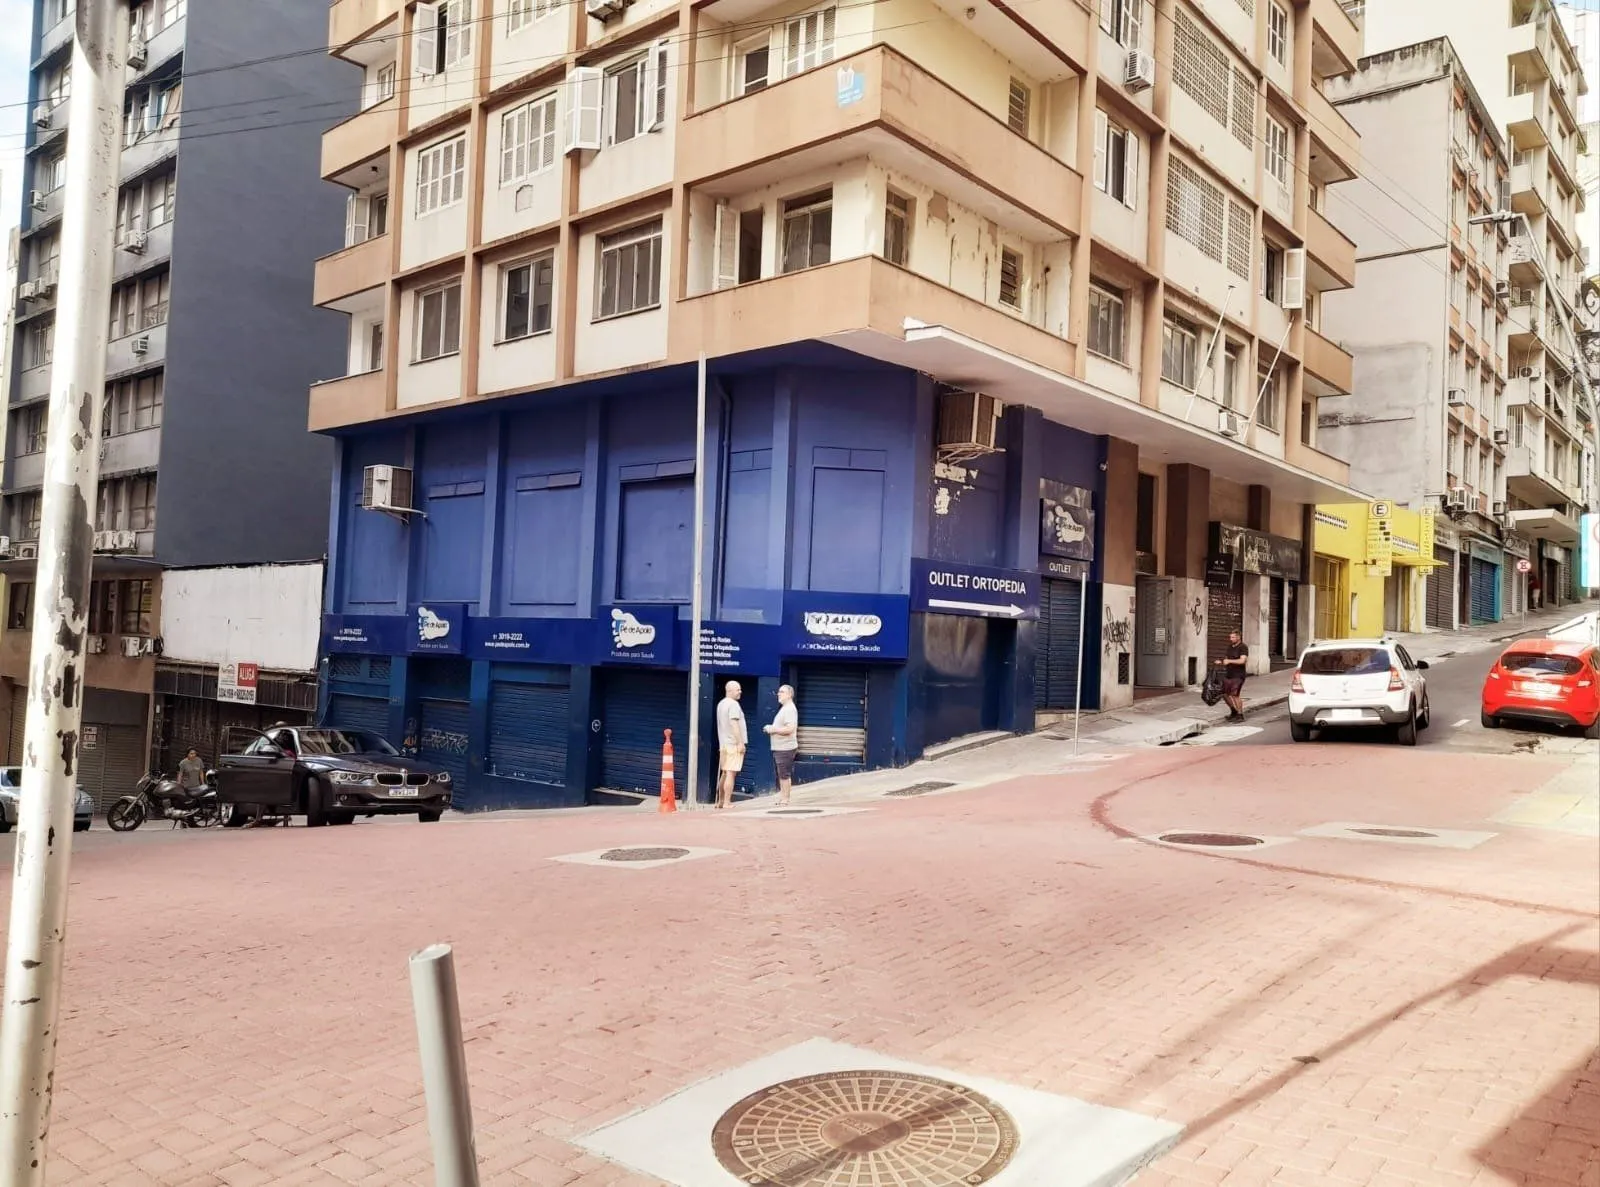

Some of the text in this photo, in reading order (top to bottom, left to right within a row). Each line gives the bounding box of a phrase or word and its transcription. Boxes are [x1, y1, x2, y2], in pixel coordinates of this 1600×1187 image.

[1376, 504, 1384, 515] E
[1049, 562, 1071, 574] OUTLET
[929, 571, 1027, 595] OUTLET ORTOPEDIA
[635, 626, 652, 635] Apoio
[498, 632, 523, 641] 3019-2222
[239, 667, 255, 681] ALUGA
